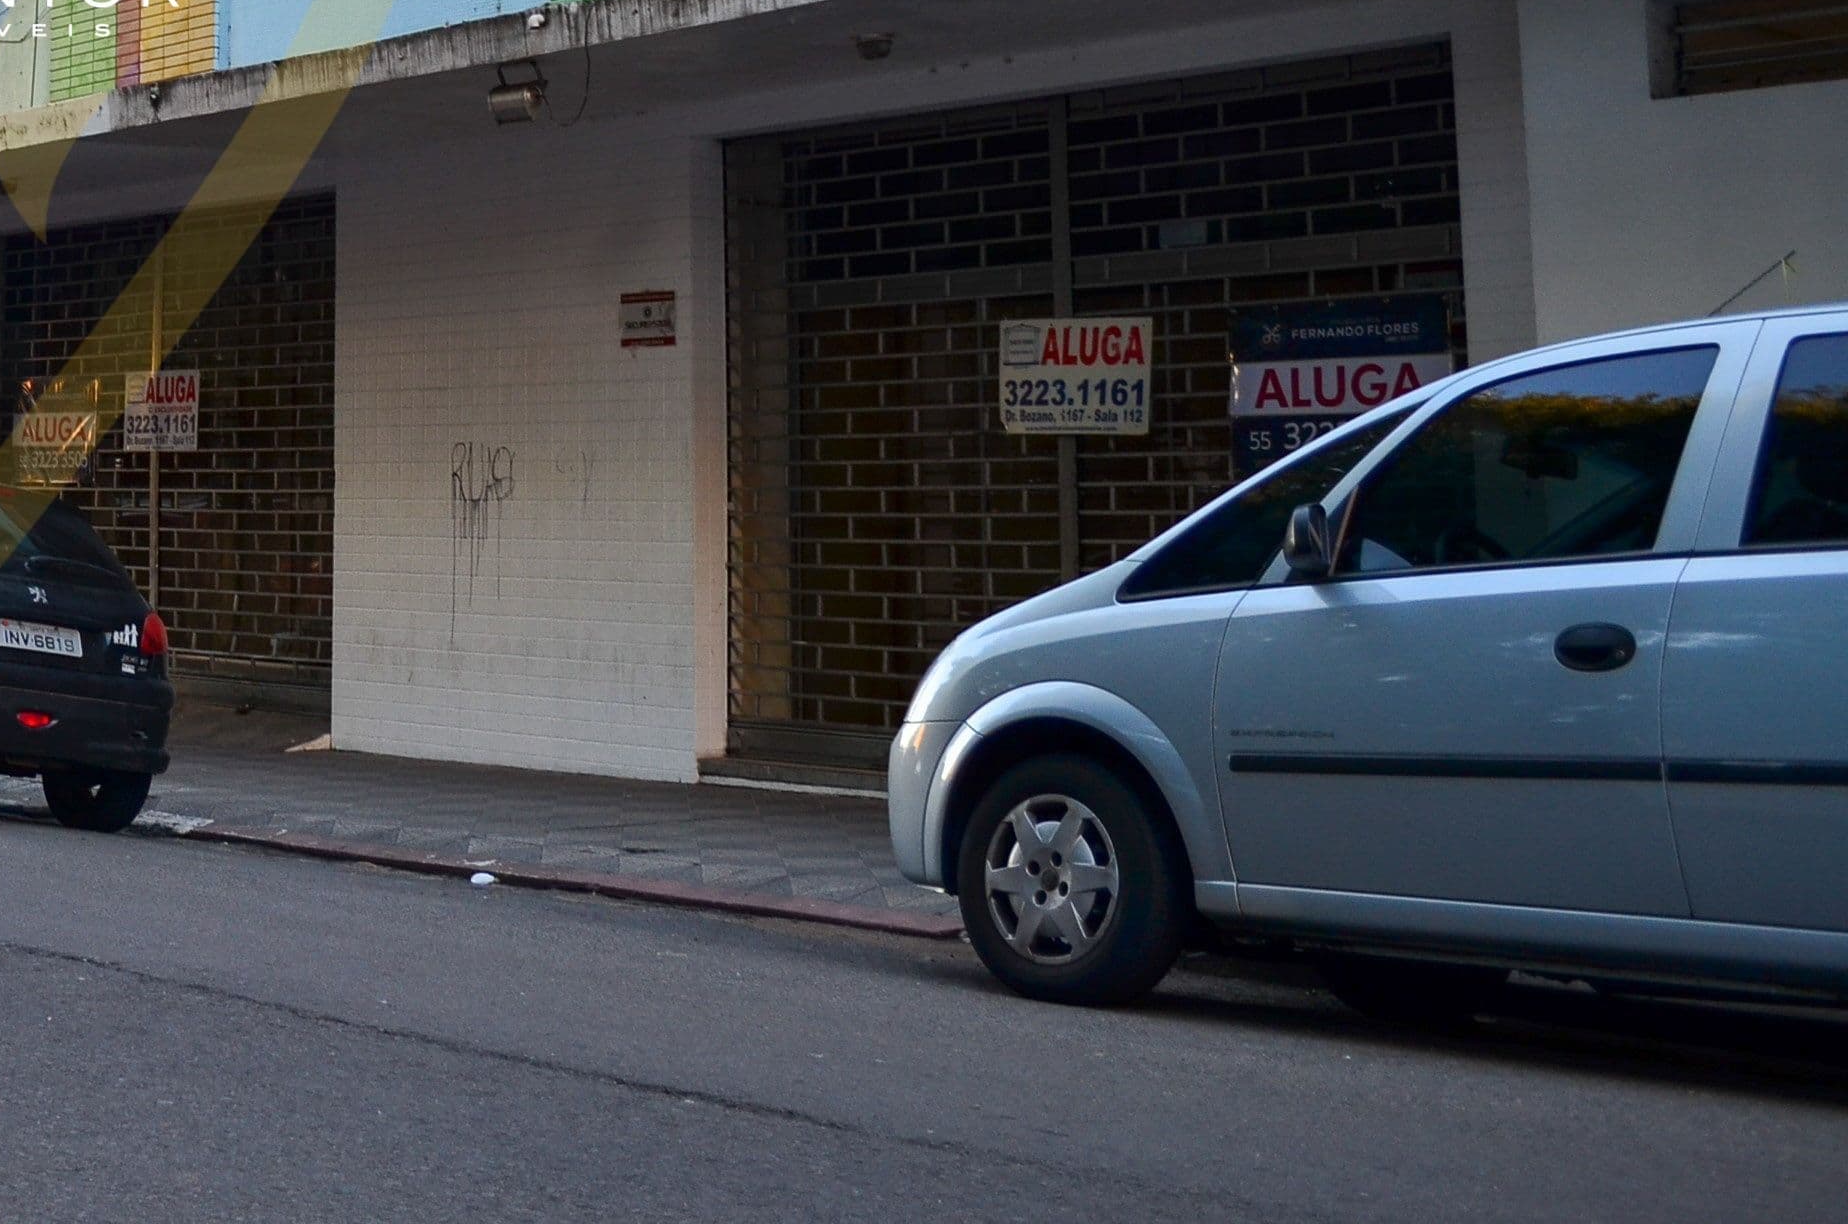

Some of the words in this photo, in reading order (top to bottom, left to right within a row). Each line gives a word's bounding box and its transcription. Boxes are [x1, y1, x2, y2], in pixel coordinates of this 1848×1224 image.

[1291, 326, 1364, 340] FERNANDO
[1367, 321, 1420, 336] FLORES
[1041, 326, 1145, 366] ALUGA
[145, 375, 196, 404] ALUGA
[1004, 379, 1144, 407] 3223.1161
[1255, 362, 1422, 409] ALUGA
[21, 416, 88, 442] ALUGA
[126, 414, 196, 434] 3223.1161
[1019, 409, 1057, 423] Bozano,
[1094, 409, 1118, 422] Sala
[1248, 431, 1272, 451] 55
